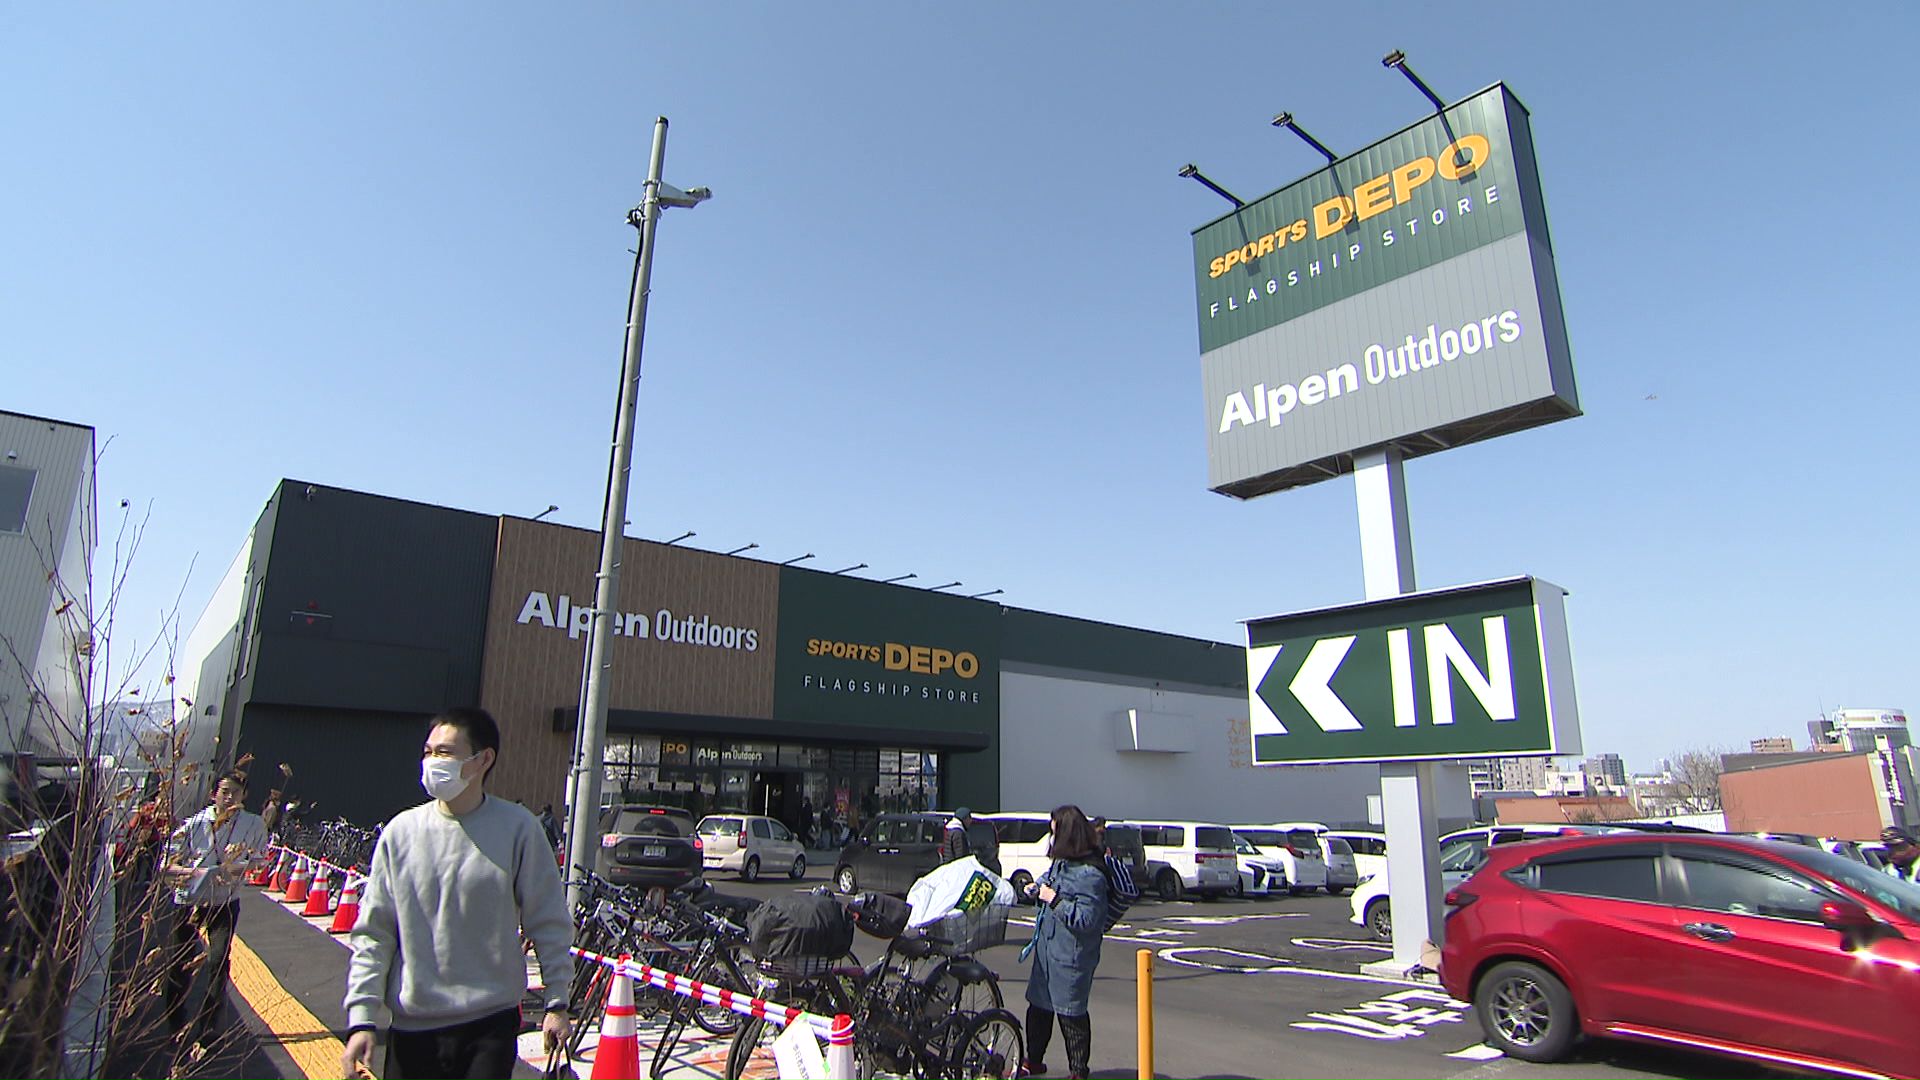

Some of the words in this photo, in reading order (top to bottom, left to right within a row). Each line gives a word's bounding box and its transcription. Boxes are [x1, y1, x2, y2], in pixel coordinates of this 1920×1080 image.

[1209, 219, 1307, 279] SPORTS
[1313, 133, 1490, 240] DEPO
[1209, 244, 1360, 319] FLAGSHIP
[1382, 185, 1498, 246] STORE
[1219, 362, 1360, 433] Alpen
[1364, 309, 1522, 385] Outdoors
[655, 609, 759, 651] Outdoors
[807, 638, 881, 662] SPORTS
[884, 642, 980, 679] DEPO
[1387, 615, 1517, 727] IN
[803, 675, 911, 696] FLAGSHIP
[921, 686, 979, 704] STORE
